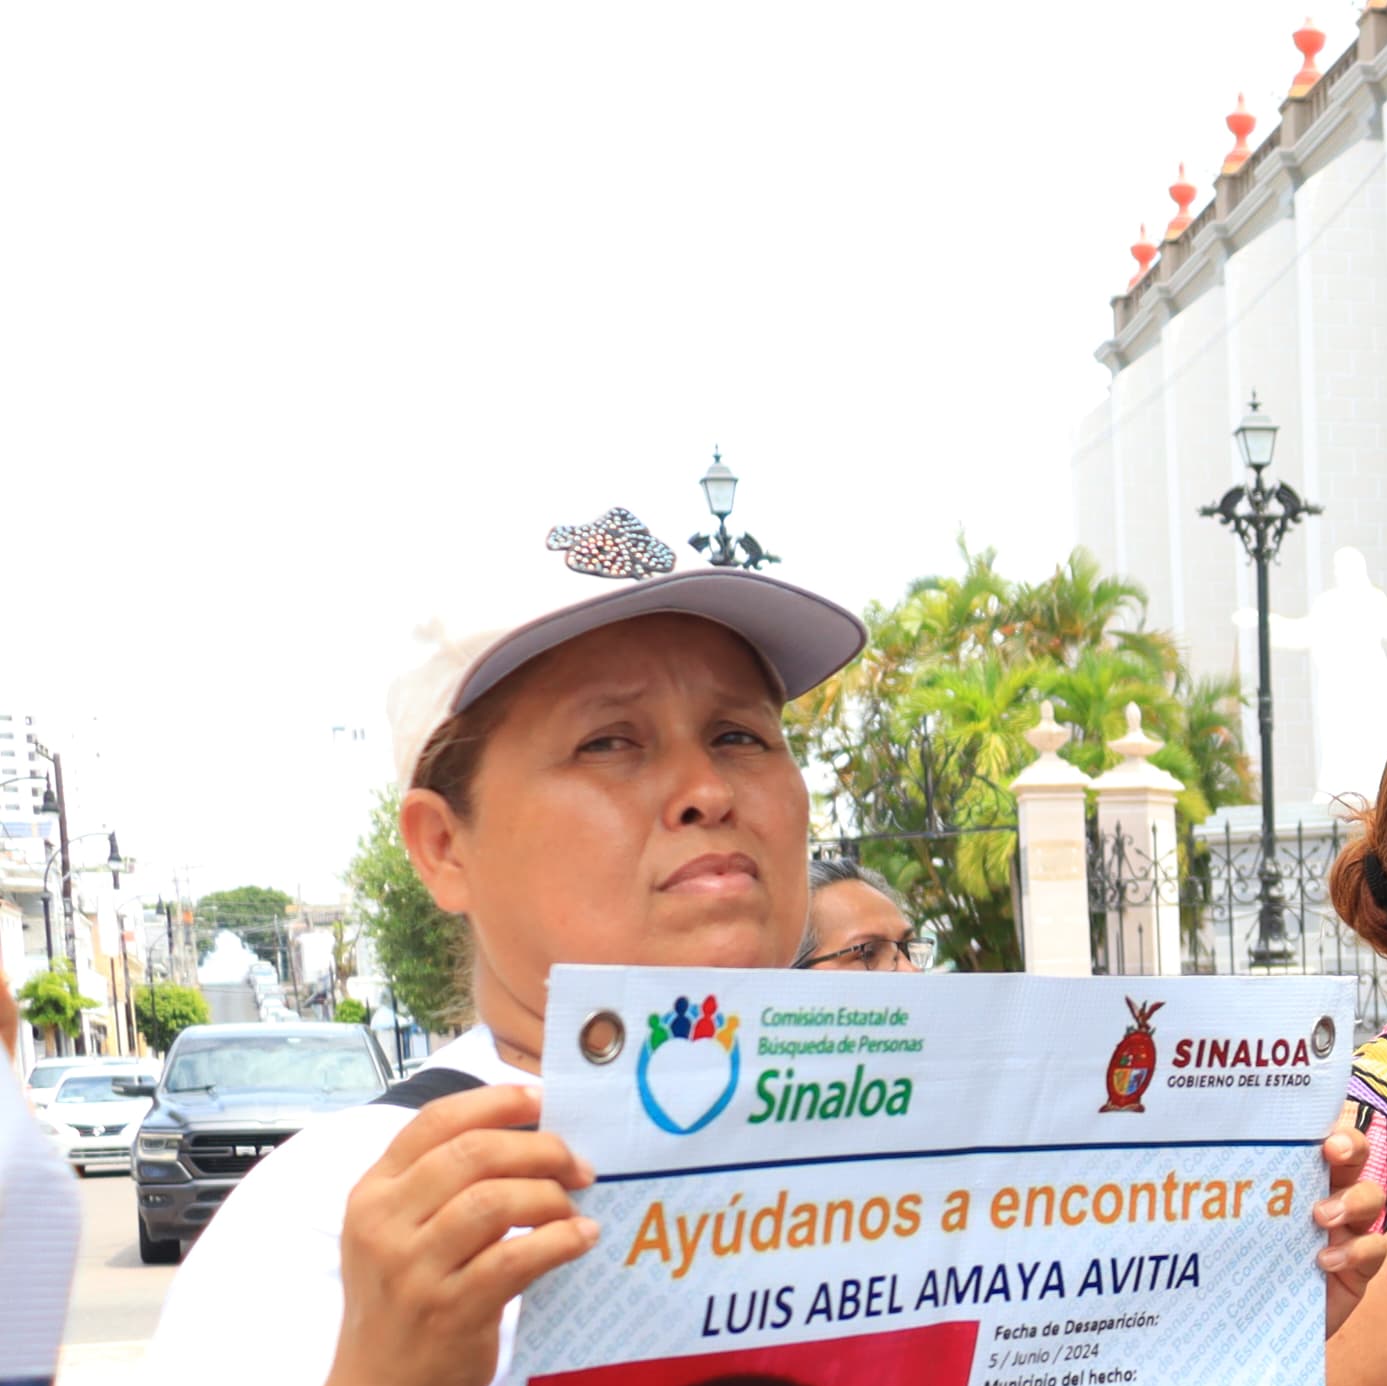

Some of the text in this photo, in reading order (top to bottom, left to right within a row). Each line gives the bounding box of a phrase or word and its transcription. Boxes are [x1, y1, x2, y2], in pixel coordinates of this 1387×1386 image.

[760, 1006, 909, 1029] Comisión Estatal de
[757, 1032, 925, 1058] Búsqueda de Personas
[1172, 1037, 1311, 1068] SINALOA
[748, 1064, 913, 1124] Sinaloa
[1167, 1074, 1312, 1089] GOBIERNO DEL ESTADO
[625, 1169, 1295, 1279] Ayúdanos a encontrar a
[702, 1252, 1202, 1337] LUIS ABEL AMAYA AVITIA
[994, 1313, 1160, 1342] Fecha de Desaparición:
[1061, 1369, 1085, 1386] del
[1088, 1367, 1138, 1385] hecho:
